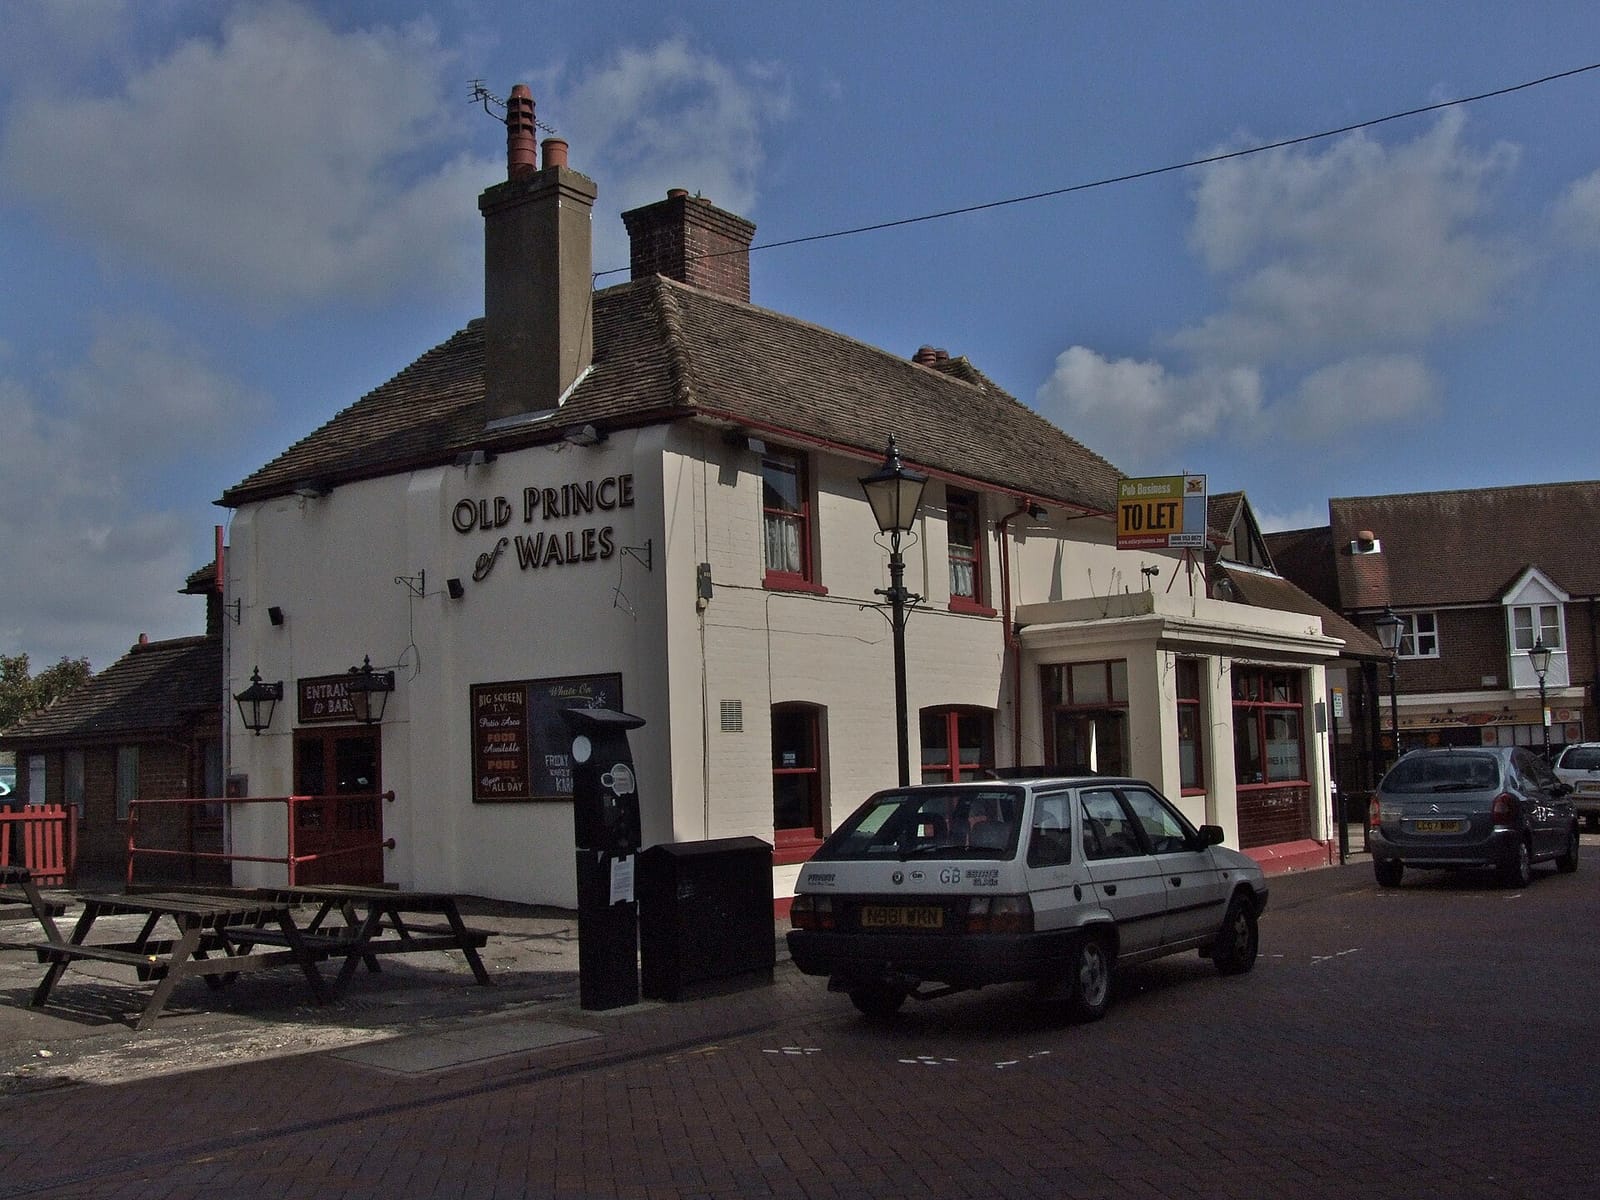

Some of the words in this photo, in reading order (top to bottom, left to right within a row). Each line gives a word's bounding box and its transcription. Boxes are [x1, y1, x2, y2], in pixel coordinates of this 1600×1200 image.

[1122, 484, 1136, 496] Pub
[1137, 483, 1172, 495] Business
[452, 496, 511, 534] OLD
[523, 474, 635, 523] PRINCE
[1122, 503, 1143, 531] TO
[1146, 502, 1179, 530] LET
[472, 537, 509, 582] of
[515, 526, 614, 570] WALES
[306, 682, 354, 699] ENTRAN
[479, 694, 492, 707] BIG
[493, 692, 522, 704] SCREEN
[493, 703, 508, 712] T.V.
[487, 732, 516, 743] FOOD
[487, 760, 518, 770] POOL
[491, 782, 506, 792] ALL
[507, 782, 523, 792] DAY
[940, 868, 960, 884] GB
